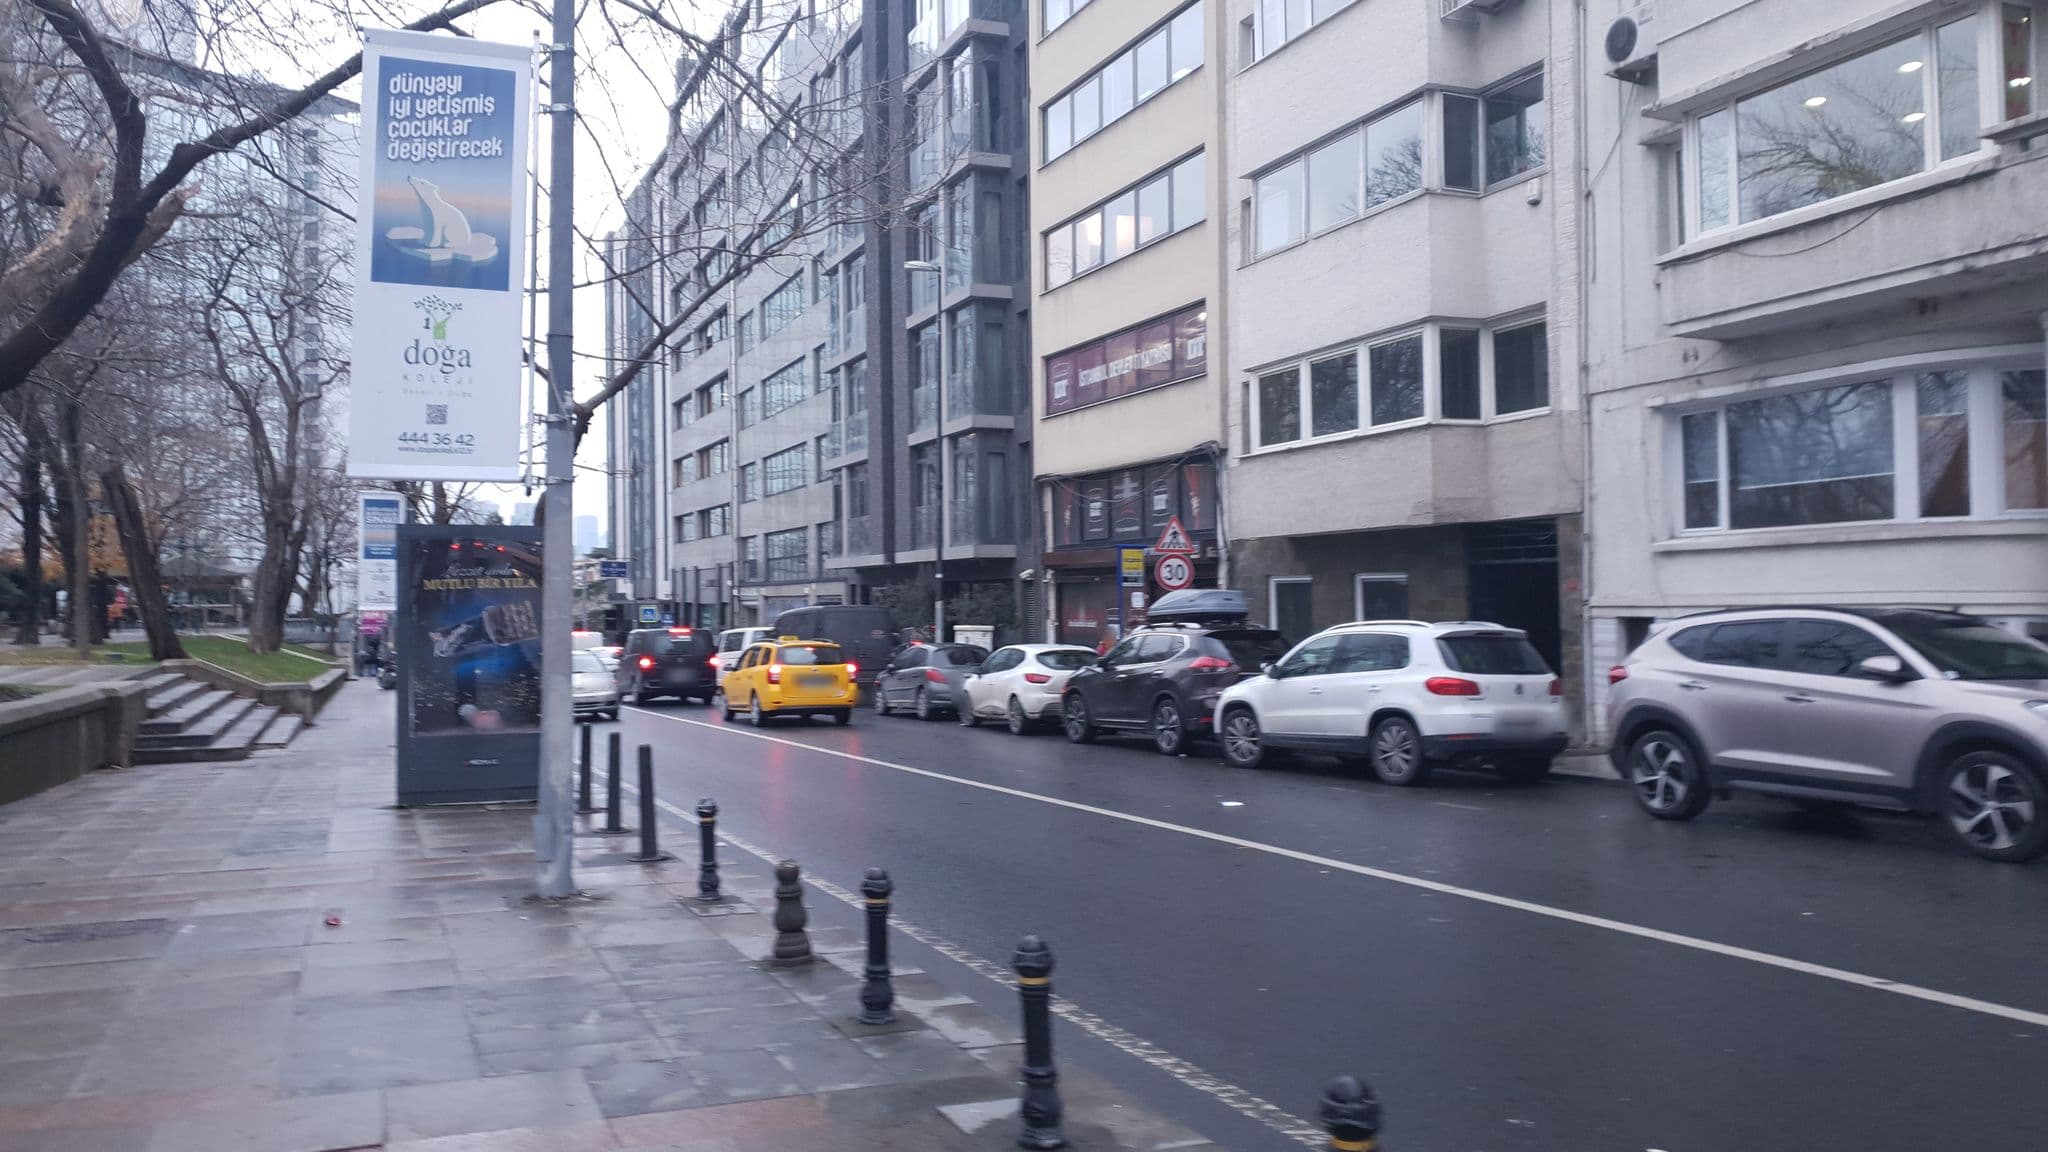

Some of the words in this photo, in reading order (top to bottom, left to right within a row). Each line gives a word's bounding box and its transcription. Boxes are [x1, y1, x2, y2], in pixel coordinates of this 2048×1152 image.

[389, 72, 463, 96] dünyayı
[389, 95, 412, 119] iyi
[415, 93, 495, 118] yetişmiş
[388, 116, 473, 142] çocuklar
[387, 135, 503, 162] değiştirecek
[404, 338, 472, 375] doğa
[398, 431, 428, 443] 444
[431, 433, 453, 446] 36
[455, 434, 475, 447] 42
[1163, 563, 1186, 582] 30
